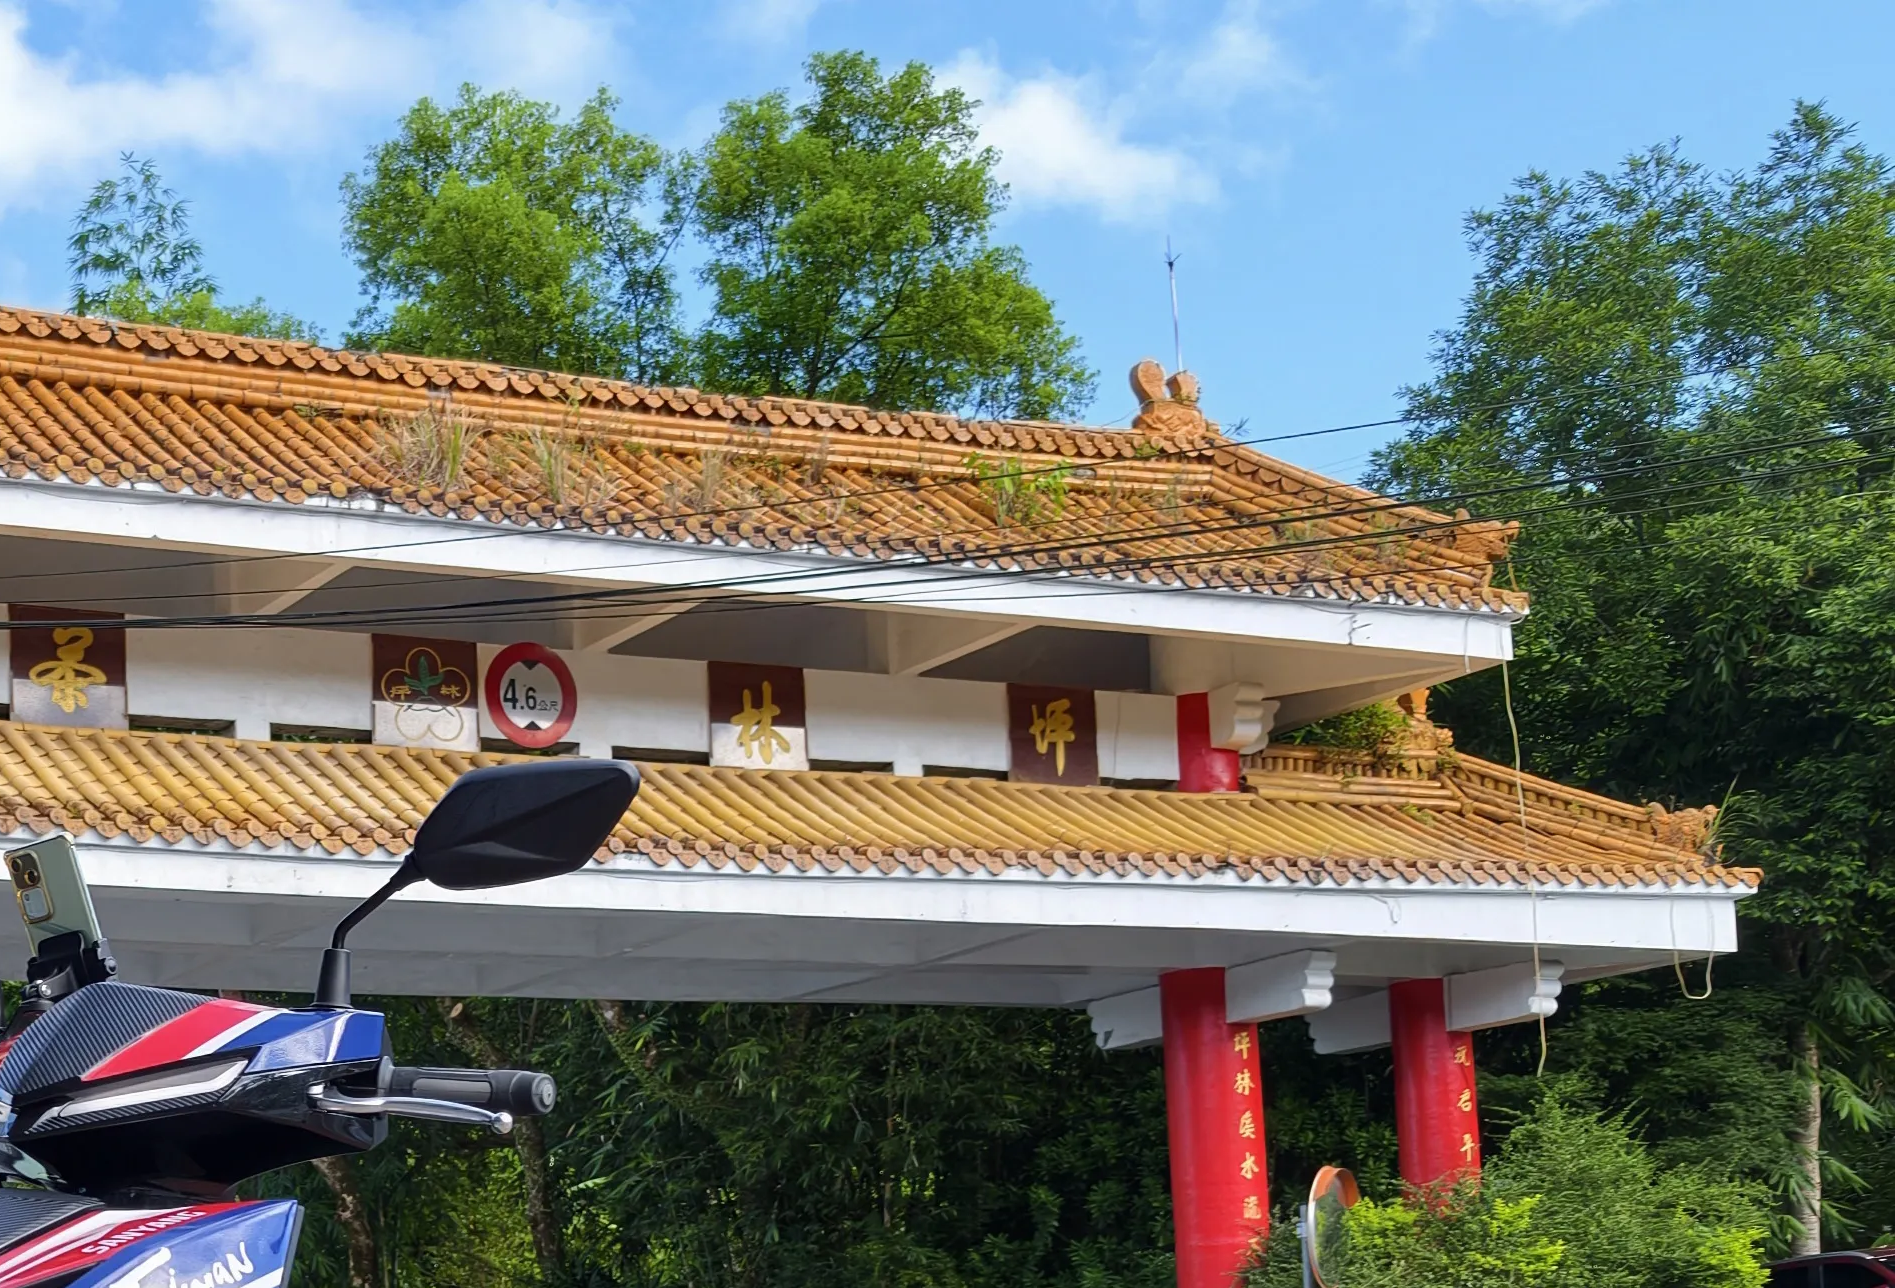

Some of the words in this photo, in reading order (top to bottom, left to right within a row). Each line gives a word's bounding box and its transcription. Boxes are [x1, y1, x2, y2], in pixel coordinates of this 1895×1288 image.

[503, 678, 537, 711] 4.6
[537, 698, 559, 712] 公尺
[730, 681, 791, 765] 林
[1029, 698, 1075, 777] 坪
[81, 1210, 207, 1254] SANYANG
